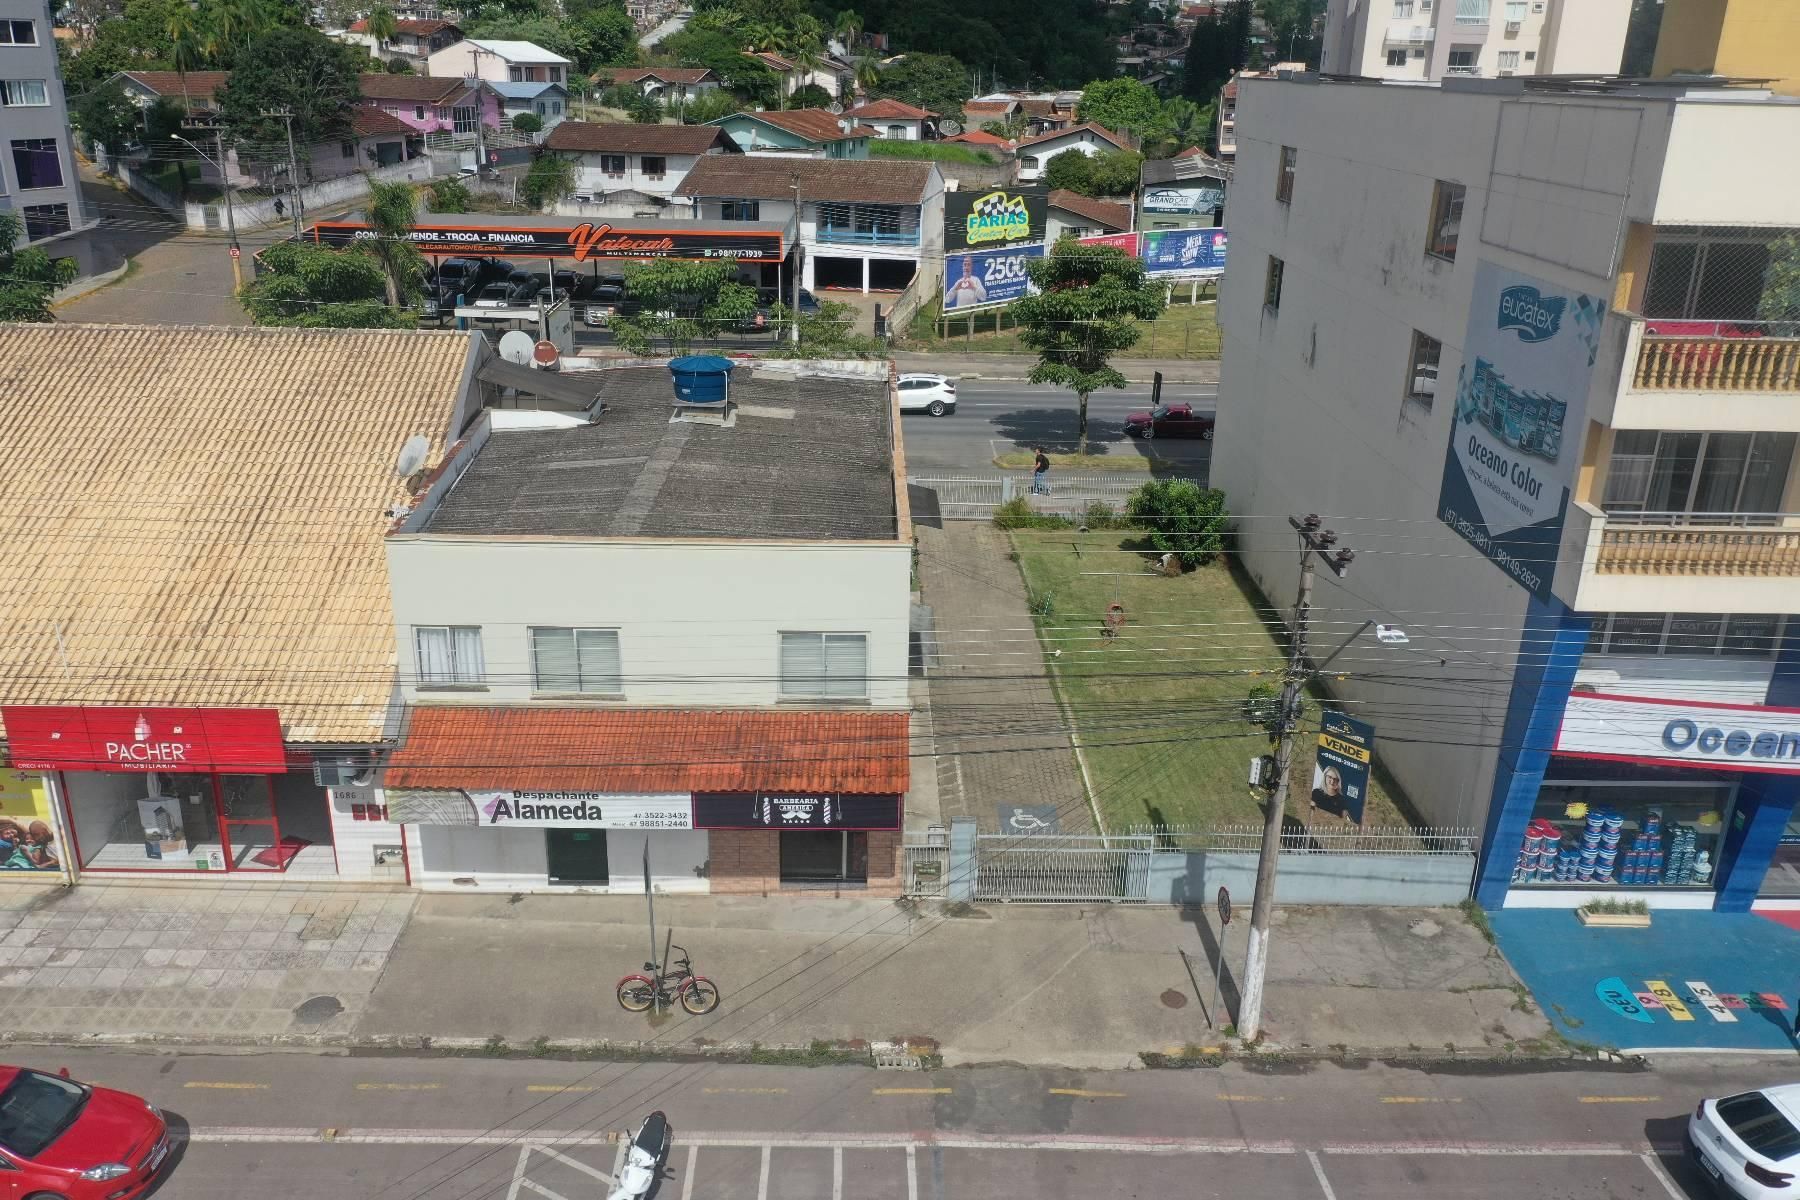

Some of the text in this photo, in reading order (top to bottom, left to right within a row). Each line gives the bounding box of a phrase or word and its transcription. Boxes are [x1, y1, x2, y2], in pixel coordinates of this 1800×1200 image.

[969, 212, 1028, 229] FARIAS
[445, 232, 480, 242] TROCA
[488, 233, 535, 243] FINANCIA
[984, 255, 1027, 281] 2500
[1502, 296, 1554, 331] eucatex
[1468, 434, 1543, 501] Oceano Color
[1444, 507, 1458, 528] (47)
[1497, 548, 1541, 591] 99149-2627
[106, 742, 185, 761] PACHER
[1325, 737, 1363, 760] VENDE
[513, 790, 600, 801] Despachante
[490, 799, 602, 824] Alameda
[1653, 988, 1673, 998] 8
[1693, 987, 1713, 997] 5
[1708, 1004, 1727, 1014] 4
